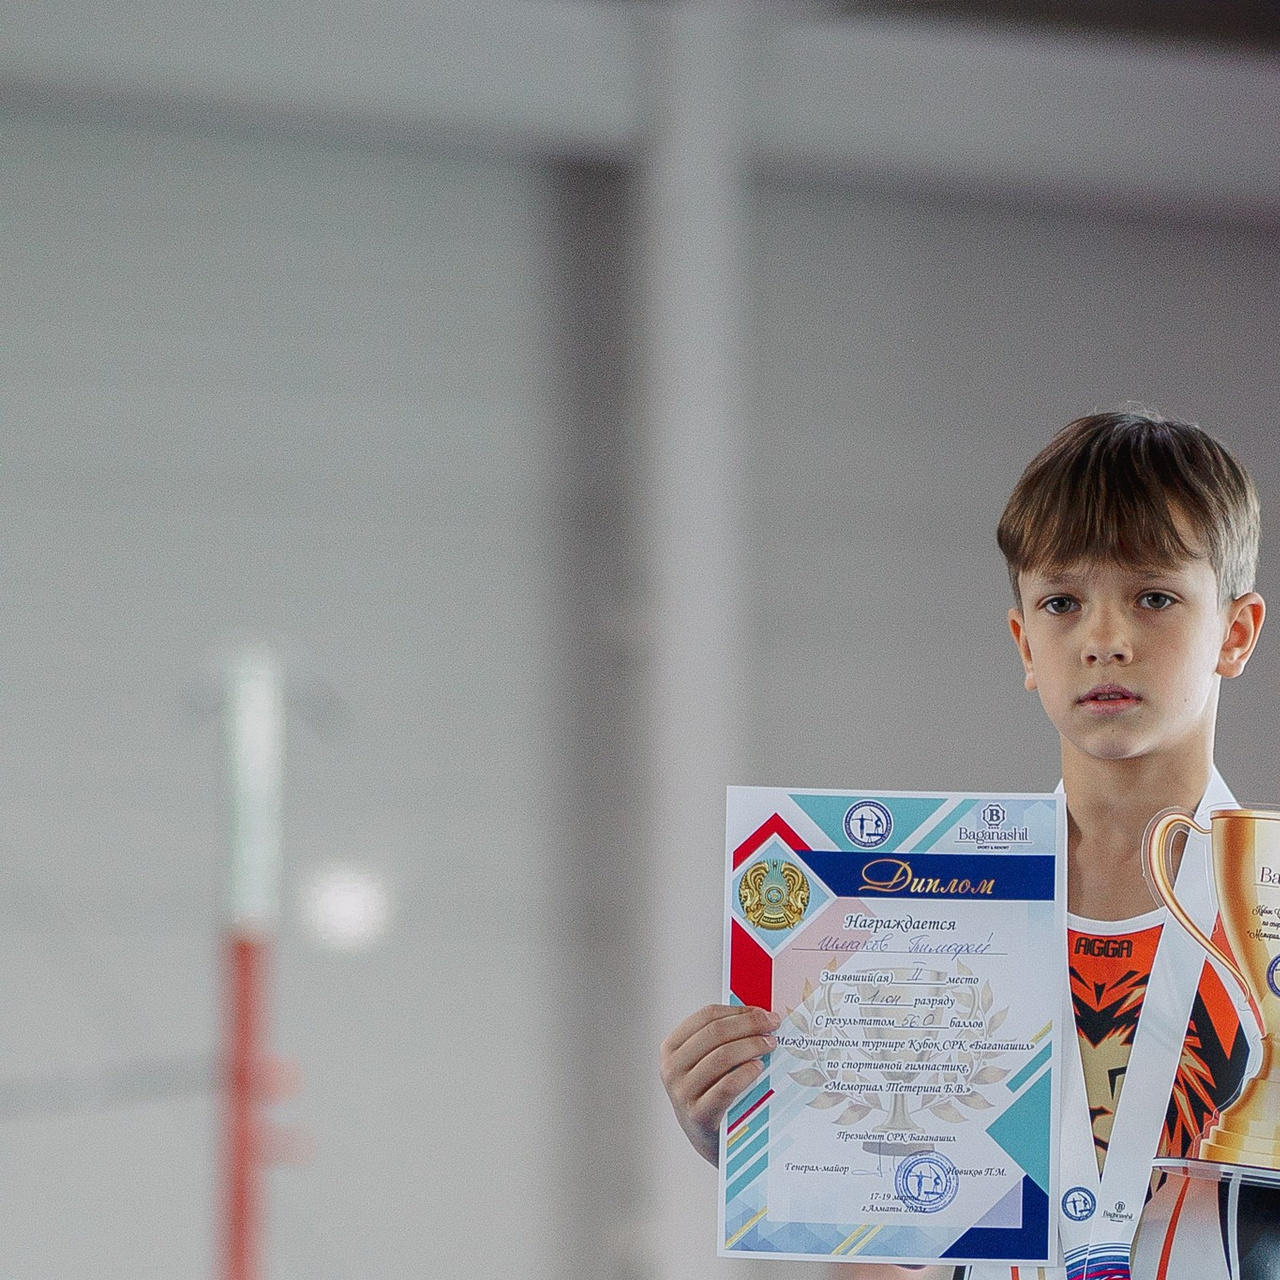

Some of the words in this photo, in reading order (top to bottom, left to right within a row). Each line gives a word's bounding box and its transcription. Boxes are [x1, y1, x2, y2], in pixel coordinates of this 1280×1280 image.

[958, 827, 1028, 844] Baganashil
[858, 858, 996, 894] Диплом
[844, 914, 956, 933] Награждается
[1074, 936, 1133, 958] AGGA
[820, 971, 894, 986] Занявший(ая)
[945, 976, 980, 985] место
[843, 993, 860, 1004] По
[913, 996, 956, 1009] разряду
[815, 1014, 824, 1026] С
[824, 1016, 895, 1028] результатом
[949, 1016, 984, 1028] баллов
[776, 1035, 859, 1050] Международном
[861, 1040, 906, 1051] турнире
[907, 1038, 943, 1051] Кубок
[942, 1039, 968, 1051] СРК
[968, 1040, 1036, 1051] «Баганашил»
[826, 1061, 839, 1069] по
[841, 1060, 903, 1073] спортивной
[904, 1063, 970, 1074] гимнастике,
[824, 1081, 883, 1094] «Мемориал
[885, 1082, 941, 1095] Тетерина
[943, 1083, 971, 1093] Б.В.»
[836, 1131, 885, 1142] Президент
[886, 1132, 909, 1143] СРК
[909, 1133, 957, 1143] Баганашил
[784, 1162, 850, 1175] Генерал-майор
[983, 1167, 1007, 1177] П.М.
[870, 1192, 892, 1201] 17-19
[861, 1204, 903, 1213] г.Алматы
